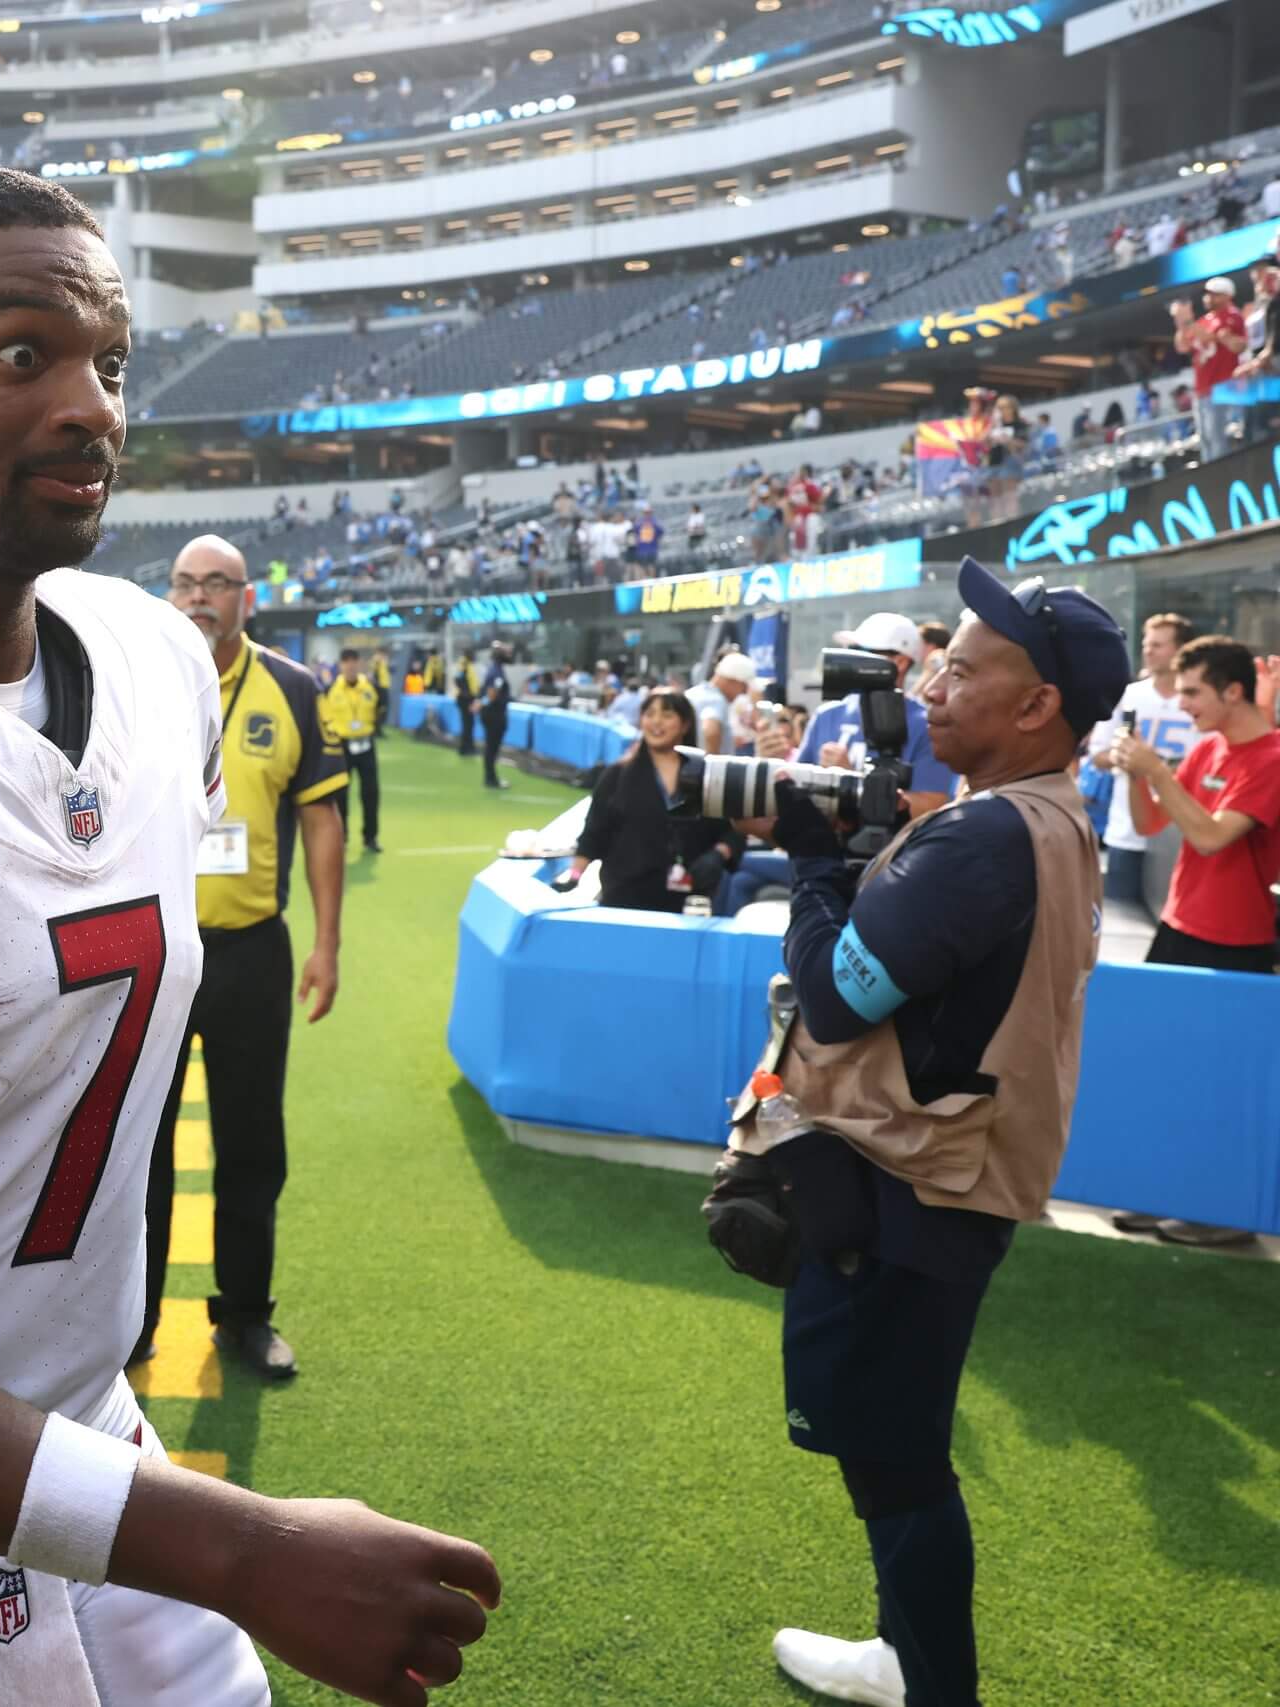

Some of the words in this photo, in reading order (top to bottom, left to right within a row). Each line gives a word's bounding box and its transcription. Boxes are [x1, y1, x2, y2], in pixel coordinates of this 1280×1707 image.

[459, 380, 567, 419] SOFI
[583, 338, 822, 402] STADIUM
[71, 811, 99, 836] NFL
[11, 893, 167, 1267] 7
